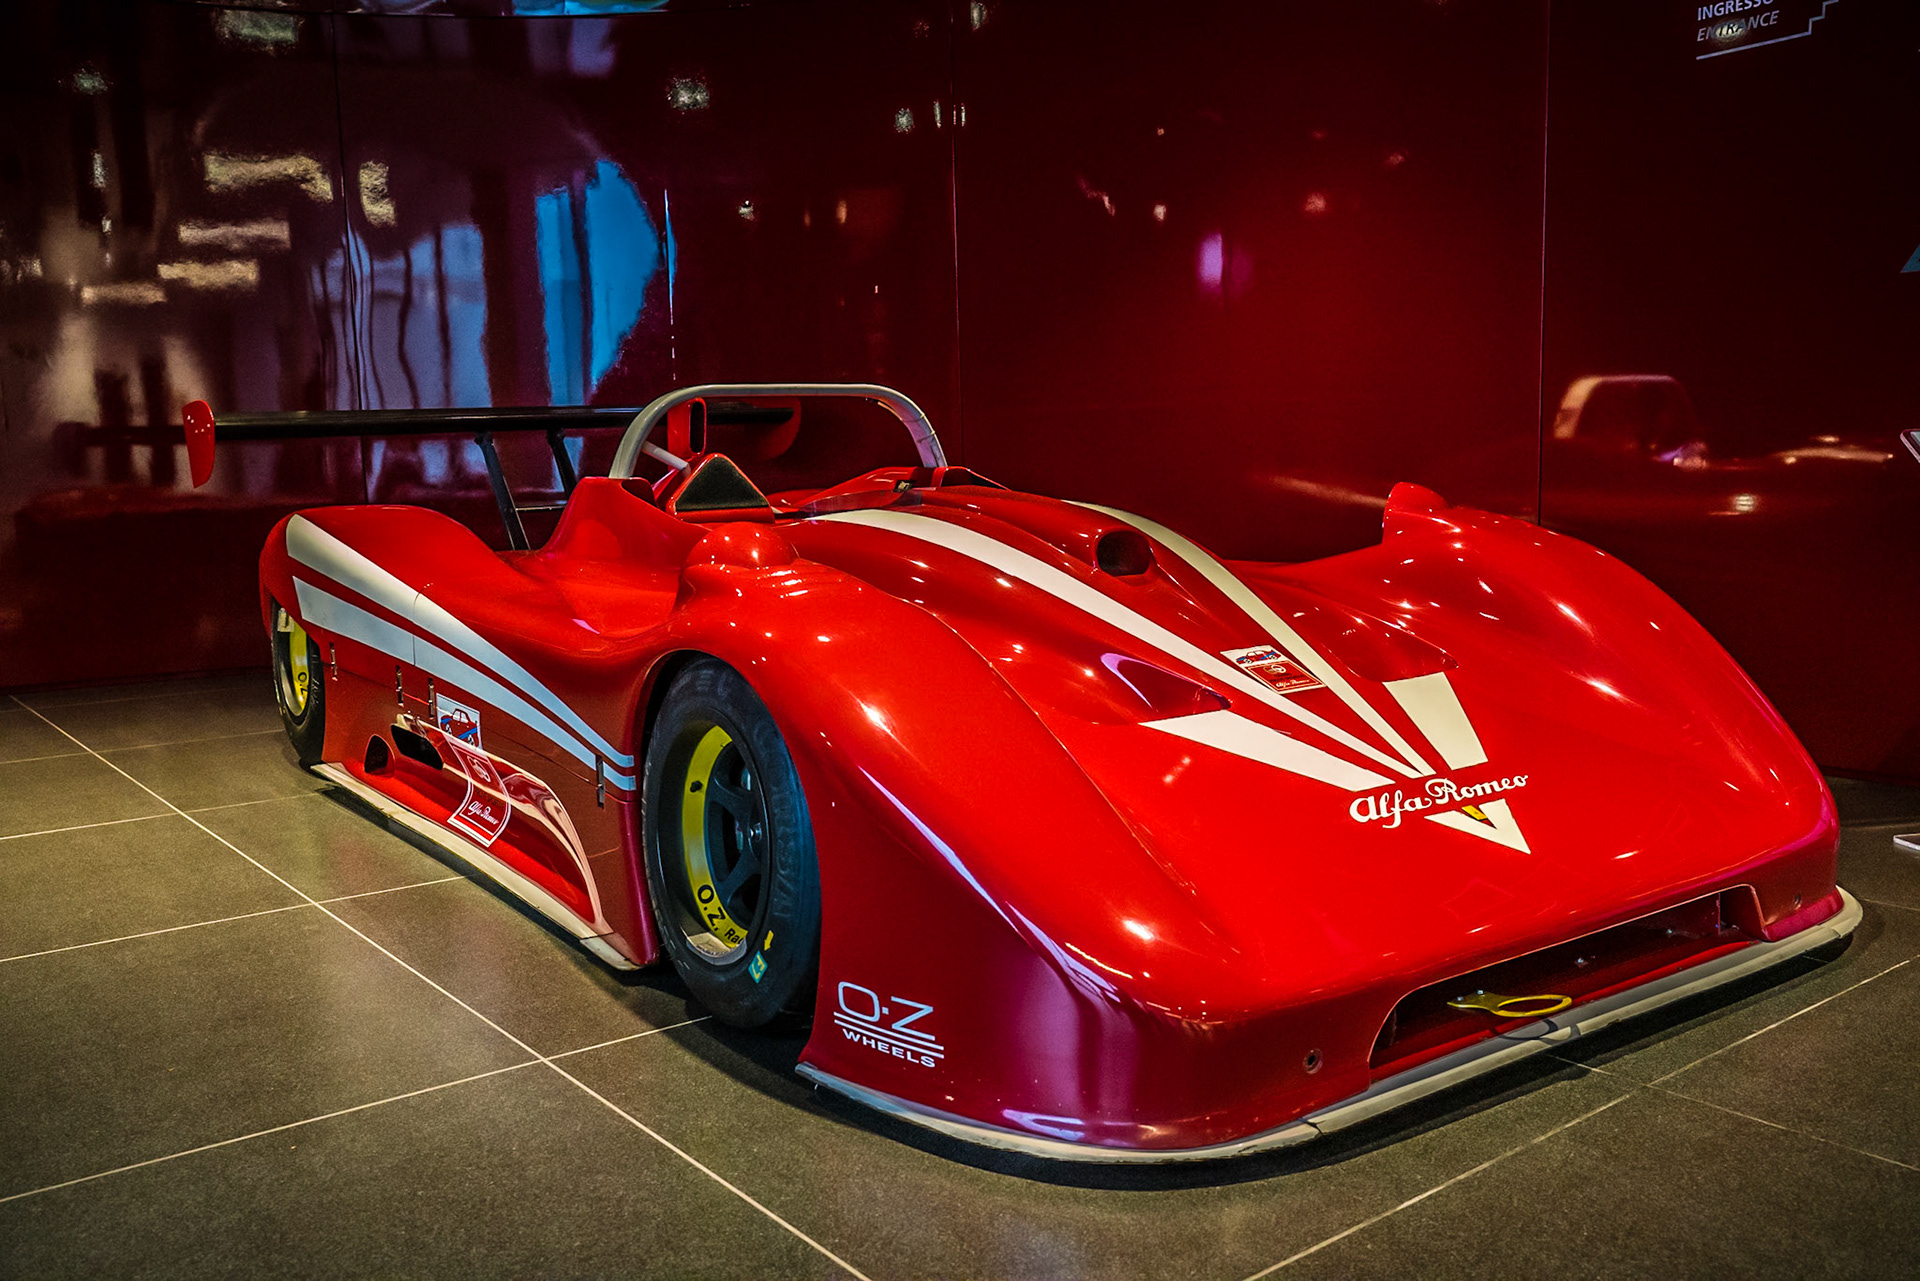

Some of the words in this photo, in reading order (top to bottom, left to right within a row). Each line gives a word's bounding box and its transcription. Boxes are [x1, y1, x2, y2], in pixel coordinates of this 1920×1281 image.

[1697, 10, 1780, 42] ENTRANCE
[1350, 790, 1432, 828] Alfa
[1425, 775, 1528, 804] Romeo
[842, 1028, 936, 1068] WHEELS
